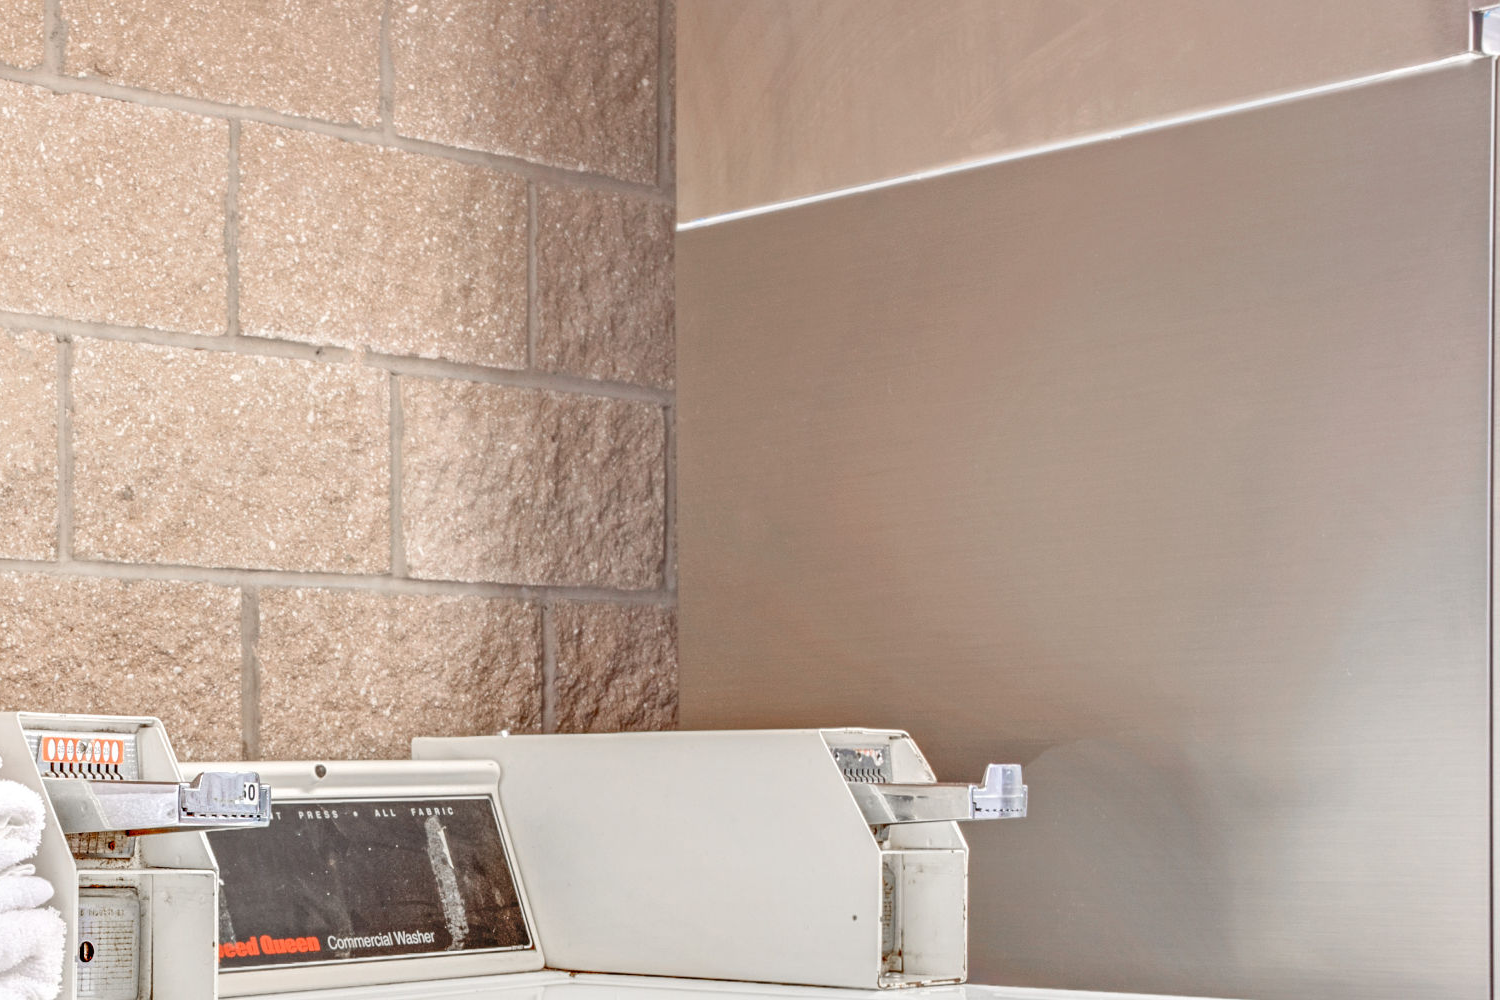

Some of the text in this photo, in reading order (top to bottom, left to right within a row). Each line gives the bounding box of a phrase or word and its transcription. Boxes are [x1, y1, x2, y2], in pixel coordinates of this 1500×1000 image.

[298, 810, 339, 819] PRESS
[374, 807, 455, 817] ALL FABRIC
[260, 934, 321, 955] Queen
[327, 933, 393, 950] Commercial
[393, 930, 435, 948] Washer
